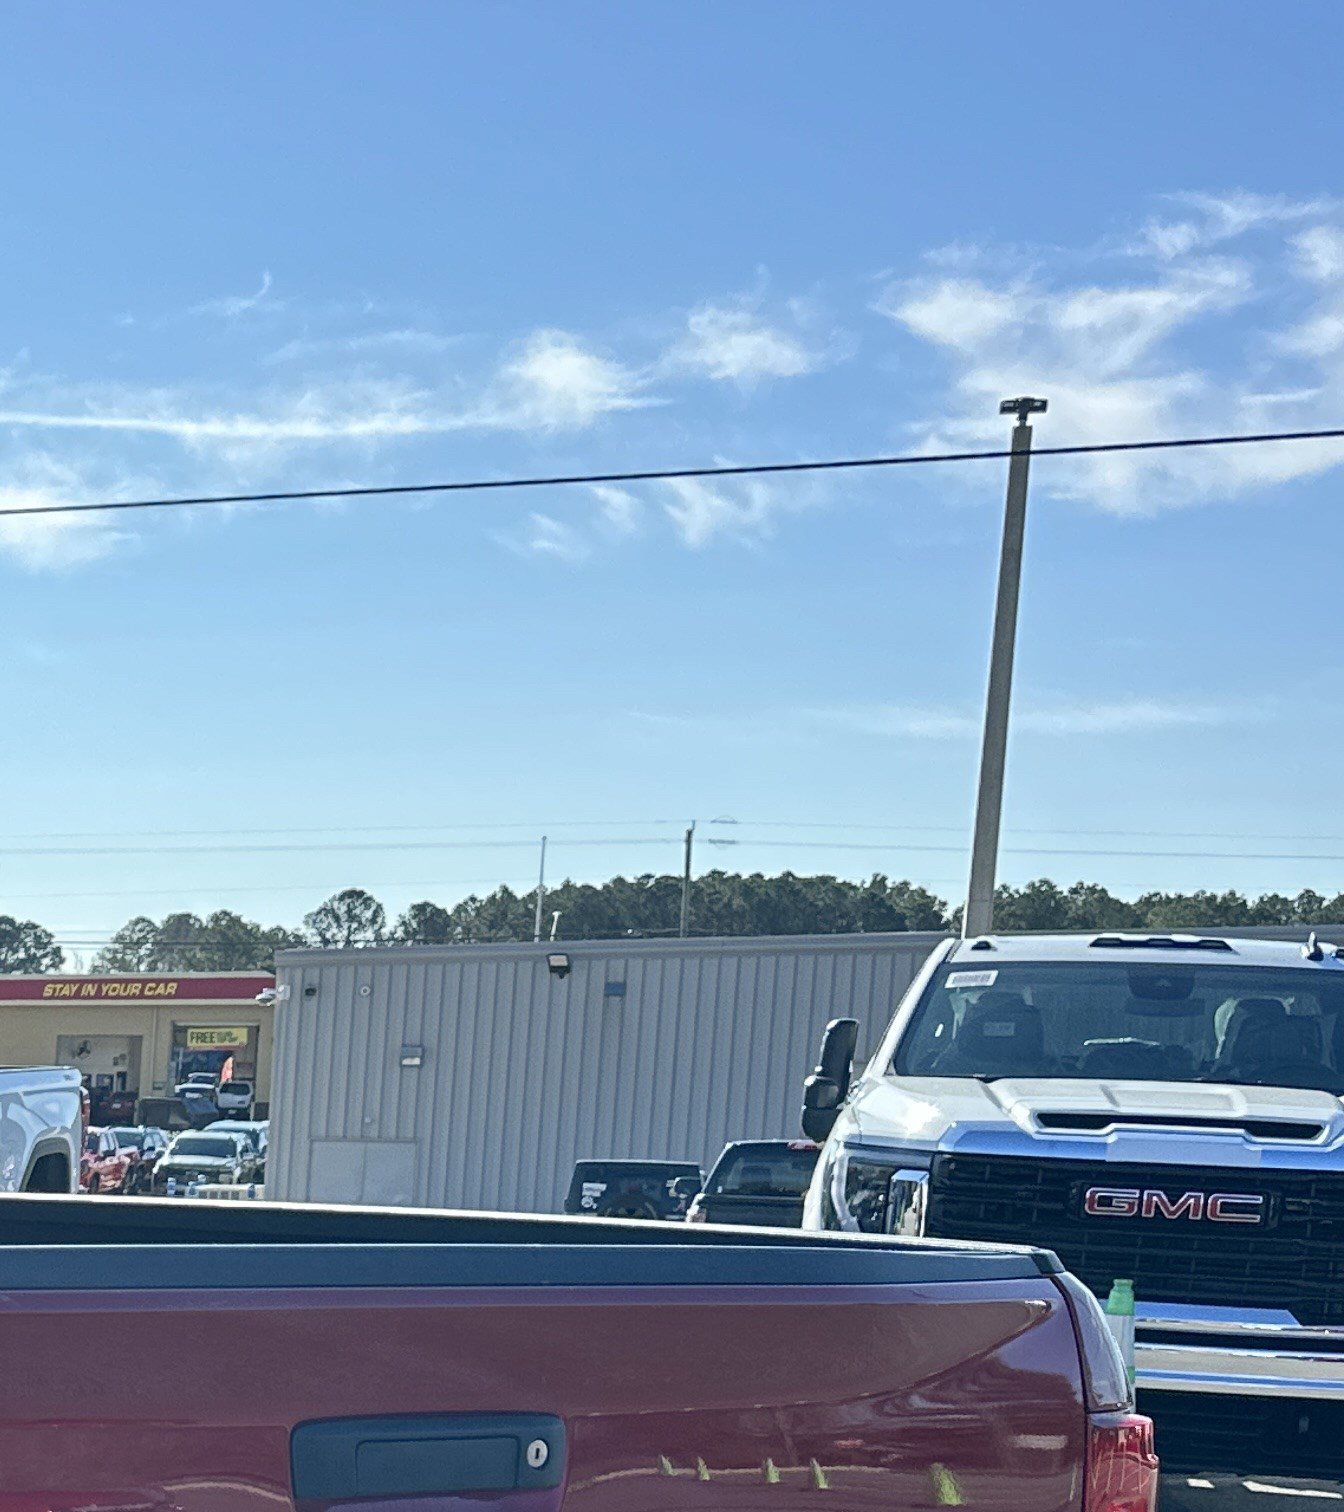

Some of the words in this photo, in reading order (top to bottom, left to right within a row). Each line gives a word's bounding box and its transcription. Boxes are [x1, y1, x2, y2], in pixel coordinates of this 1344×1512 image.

[42, 983, 80, 997] STAY
[80, 983, 98, 996] IN
[101, 982, 142, 997] YOUR
[144, 982, 178, 996] CAR
[1084, 1186, 1263, 1223] GMC
